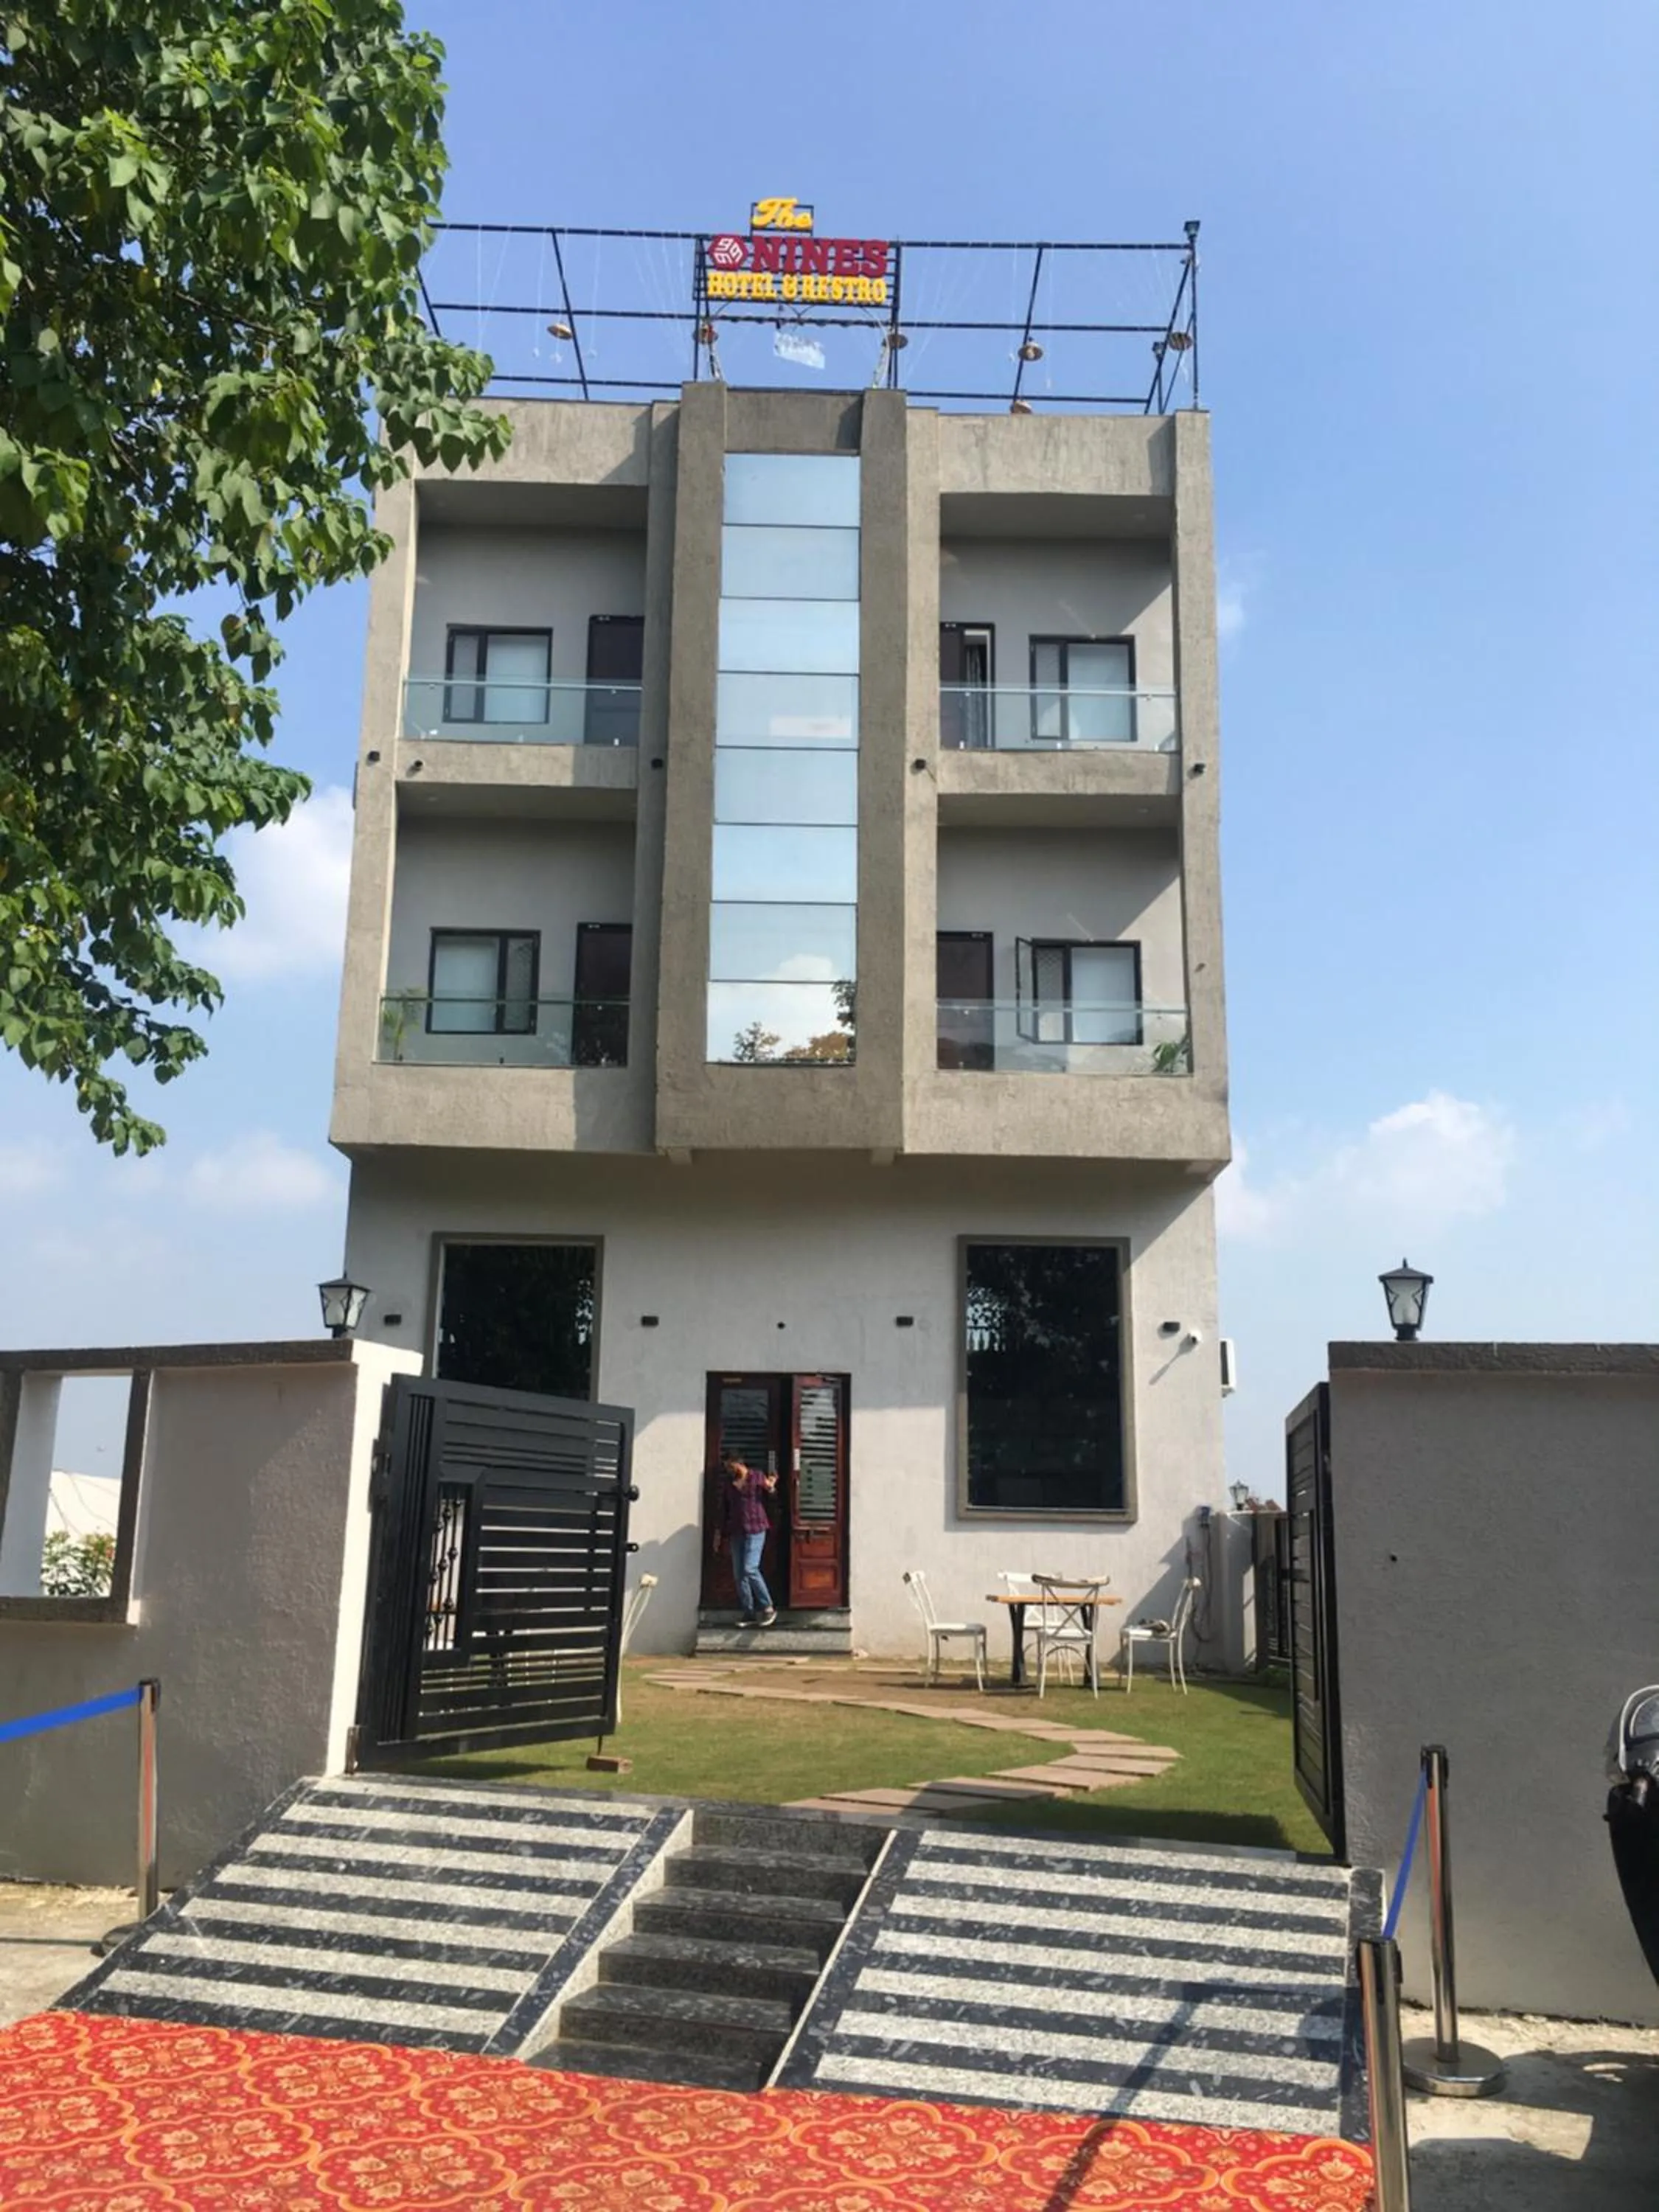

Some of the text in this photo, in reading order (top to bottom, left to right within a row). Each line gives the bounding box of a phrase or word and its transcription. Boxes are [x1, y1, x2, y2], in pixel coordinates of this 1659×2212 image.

[751, 198, 813, 228] The
[751, 236, 889, 277] NINES
[706, 272, 776, 299] HOTEL
[801, 276, 887, 304] RESTRO
